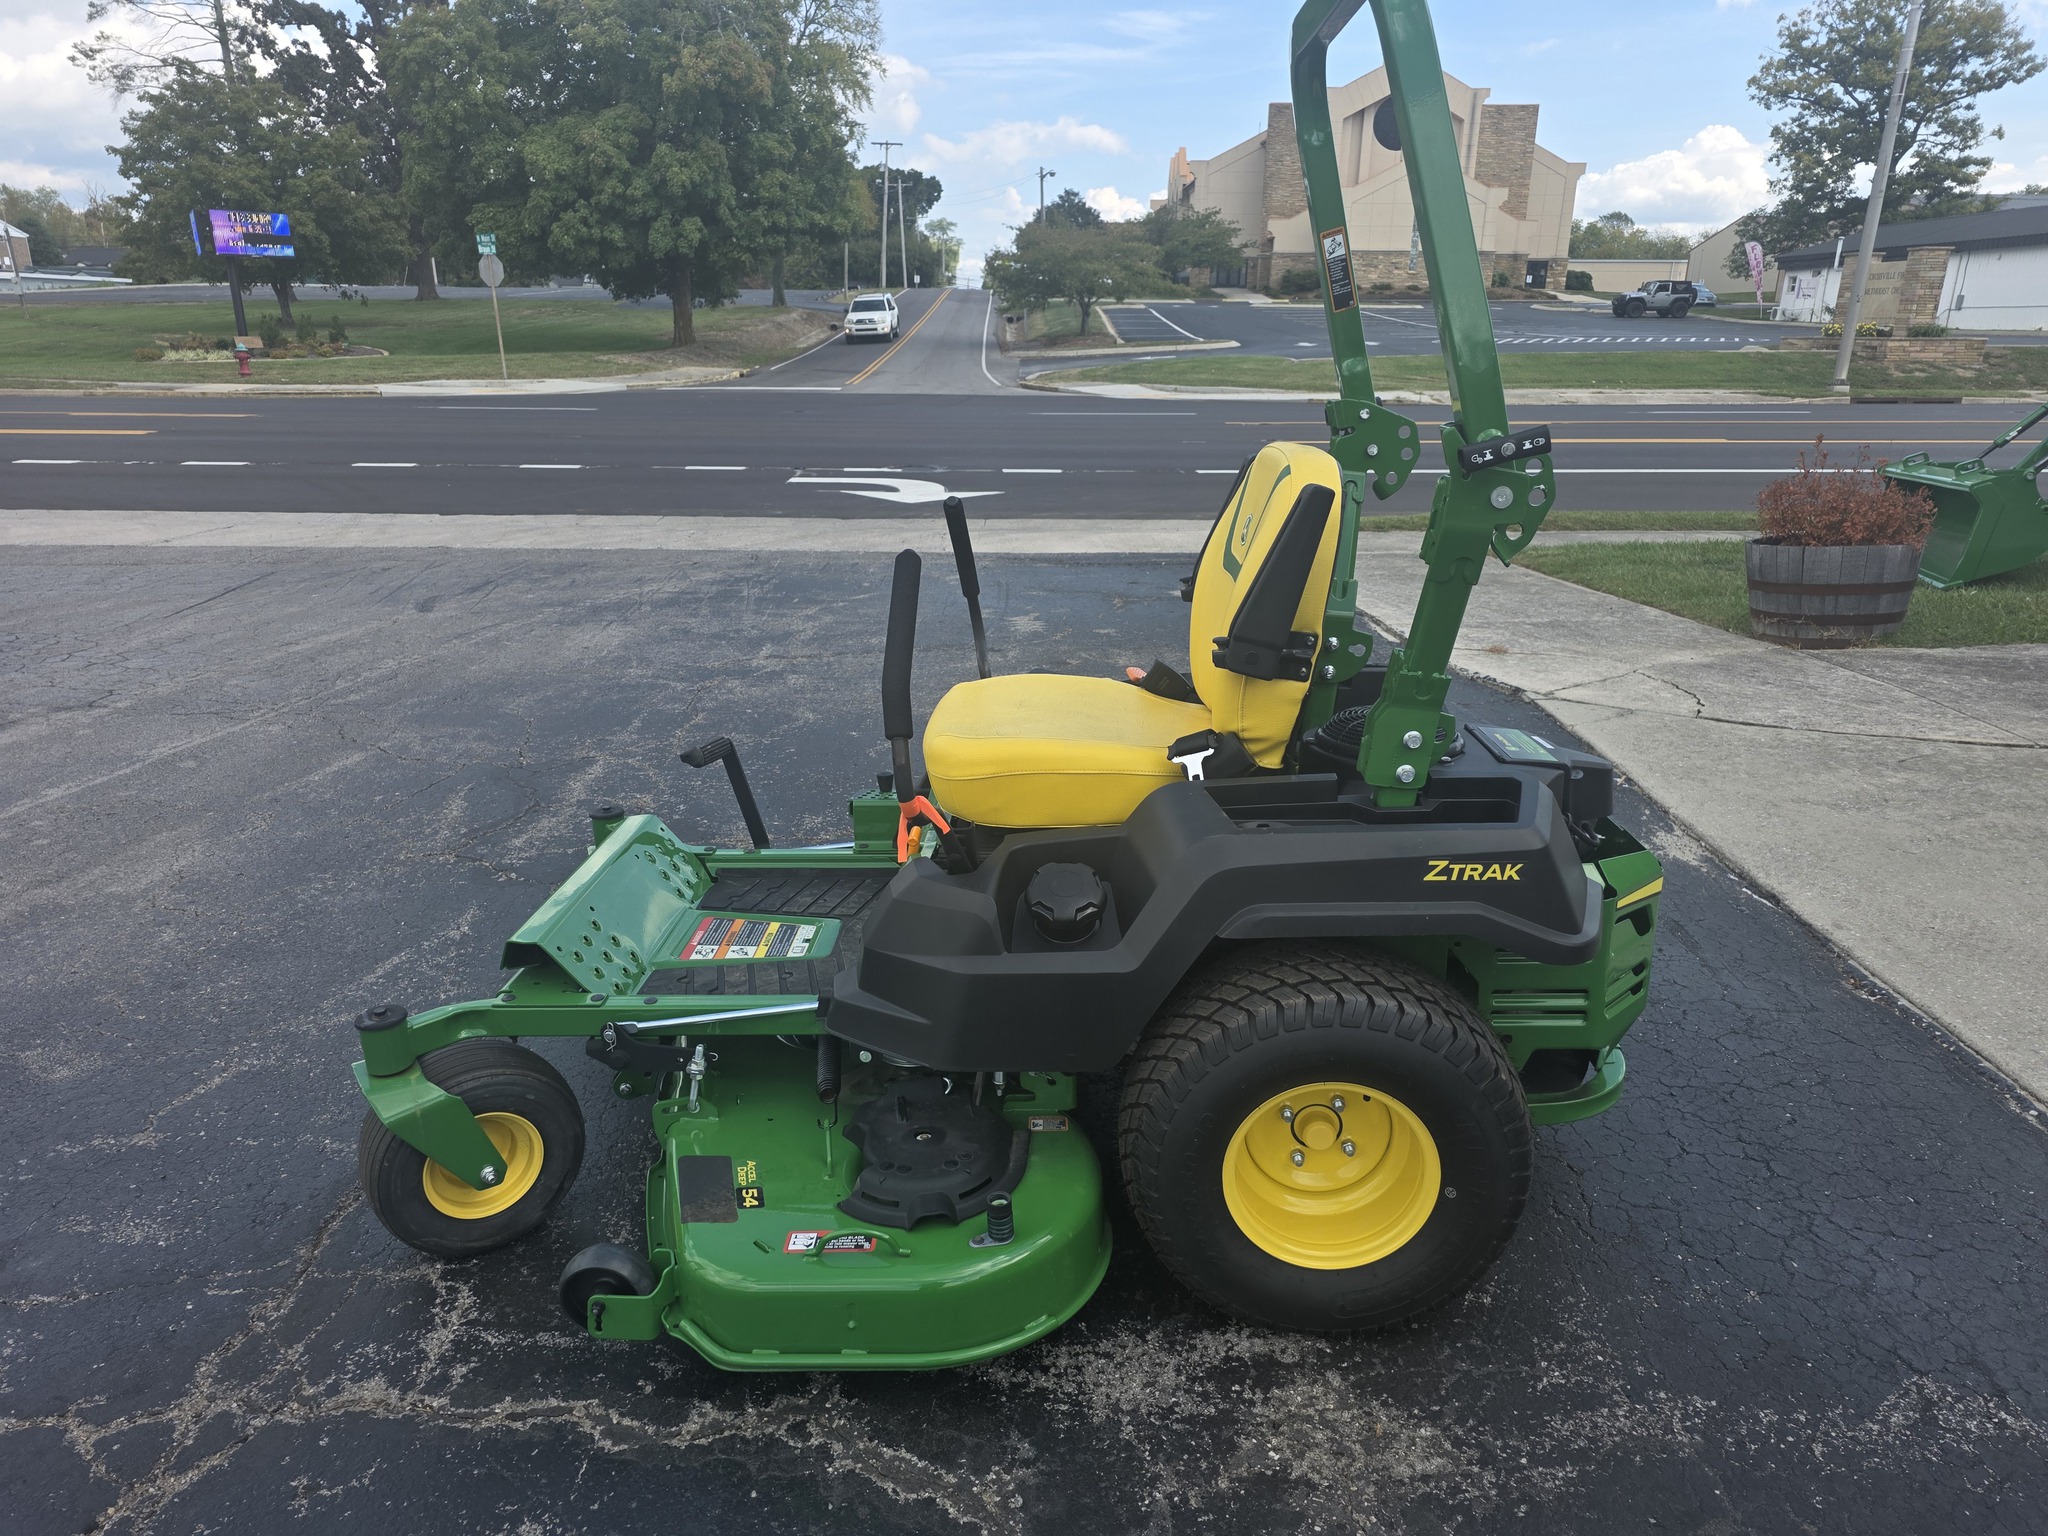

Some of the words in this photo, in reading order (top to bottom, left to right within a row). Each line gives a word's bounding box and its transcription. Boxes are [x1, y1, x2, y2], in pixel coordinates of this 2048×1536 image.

[1868, 271, 1896, 280] CROSSVILLE
[1864, 287, 1890, 296] METHODIST
[1423, 860, 1524, 881] ZTRAK
[737, 1166, 747, 1186] DEEP
[746, 1160, 757, 1183] ACCEL
[742, 1188, 759, 1208] 54
